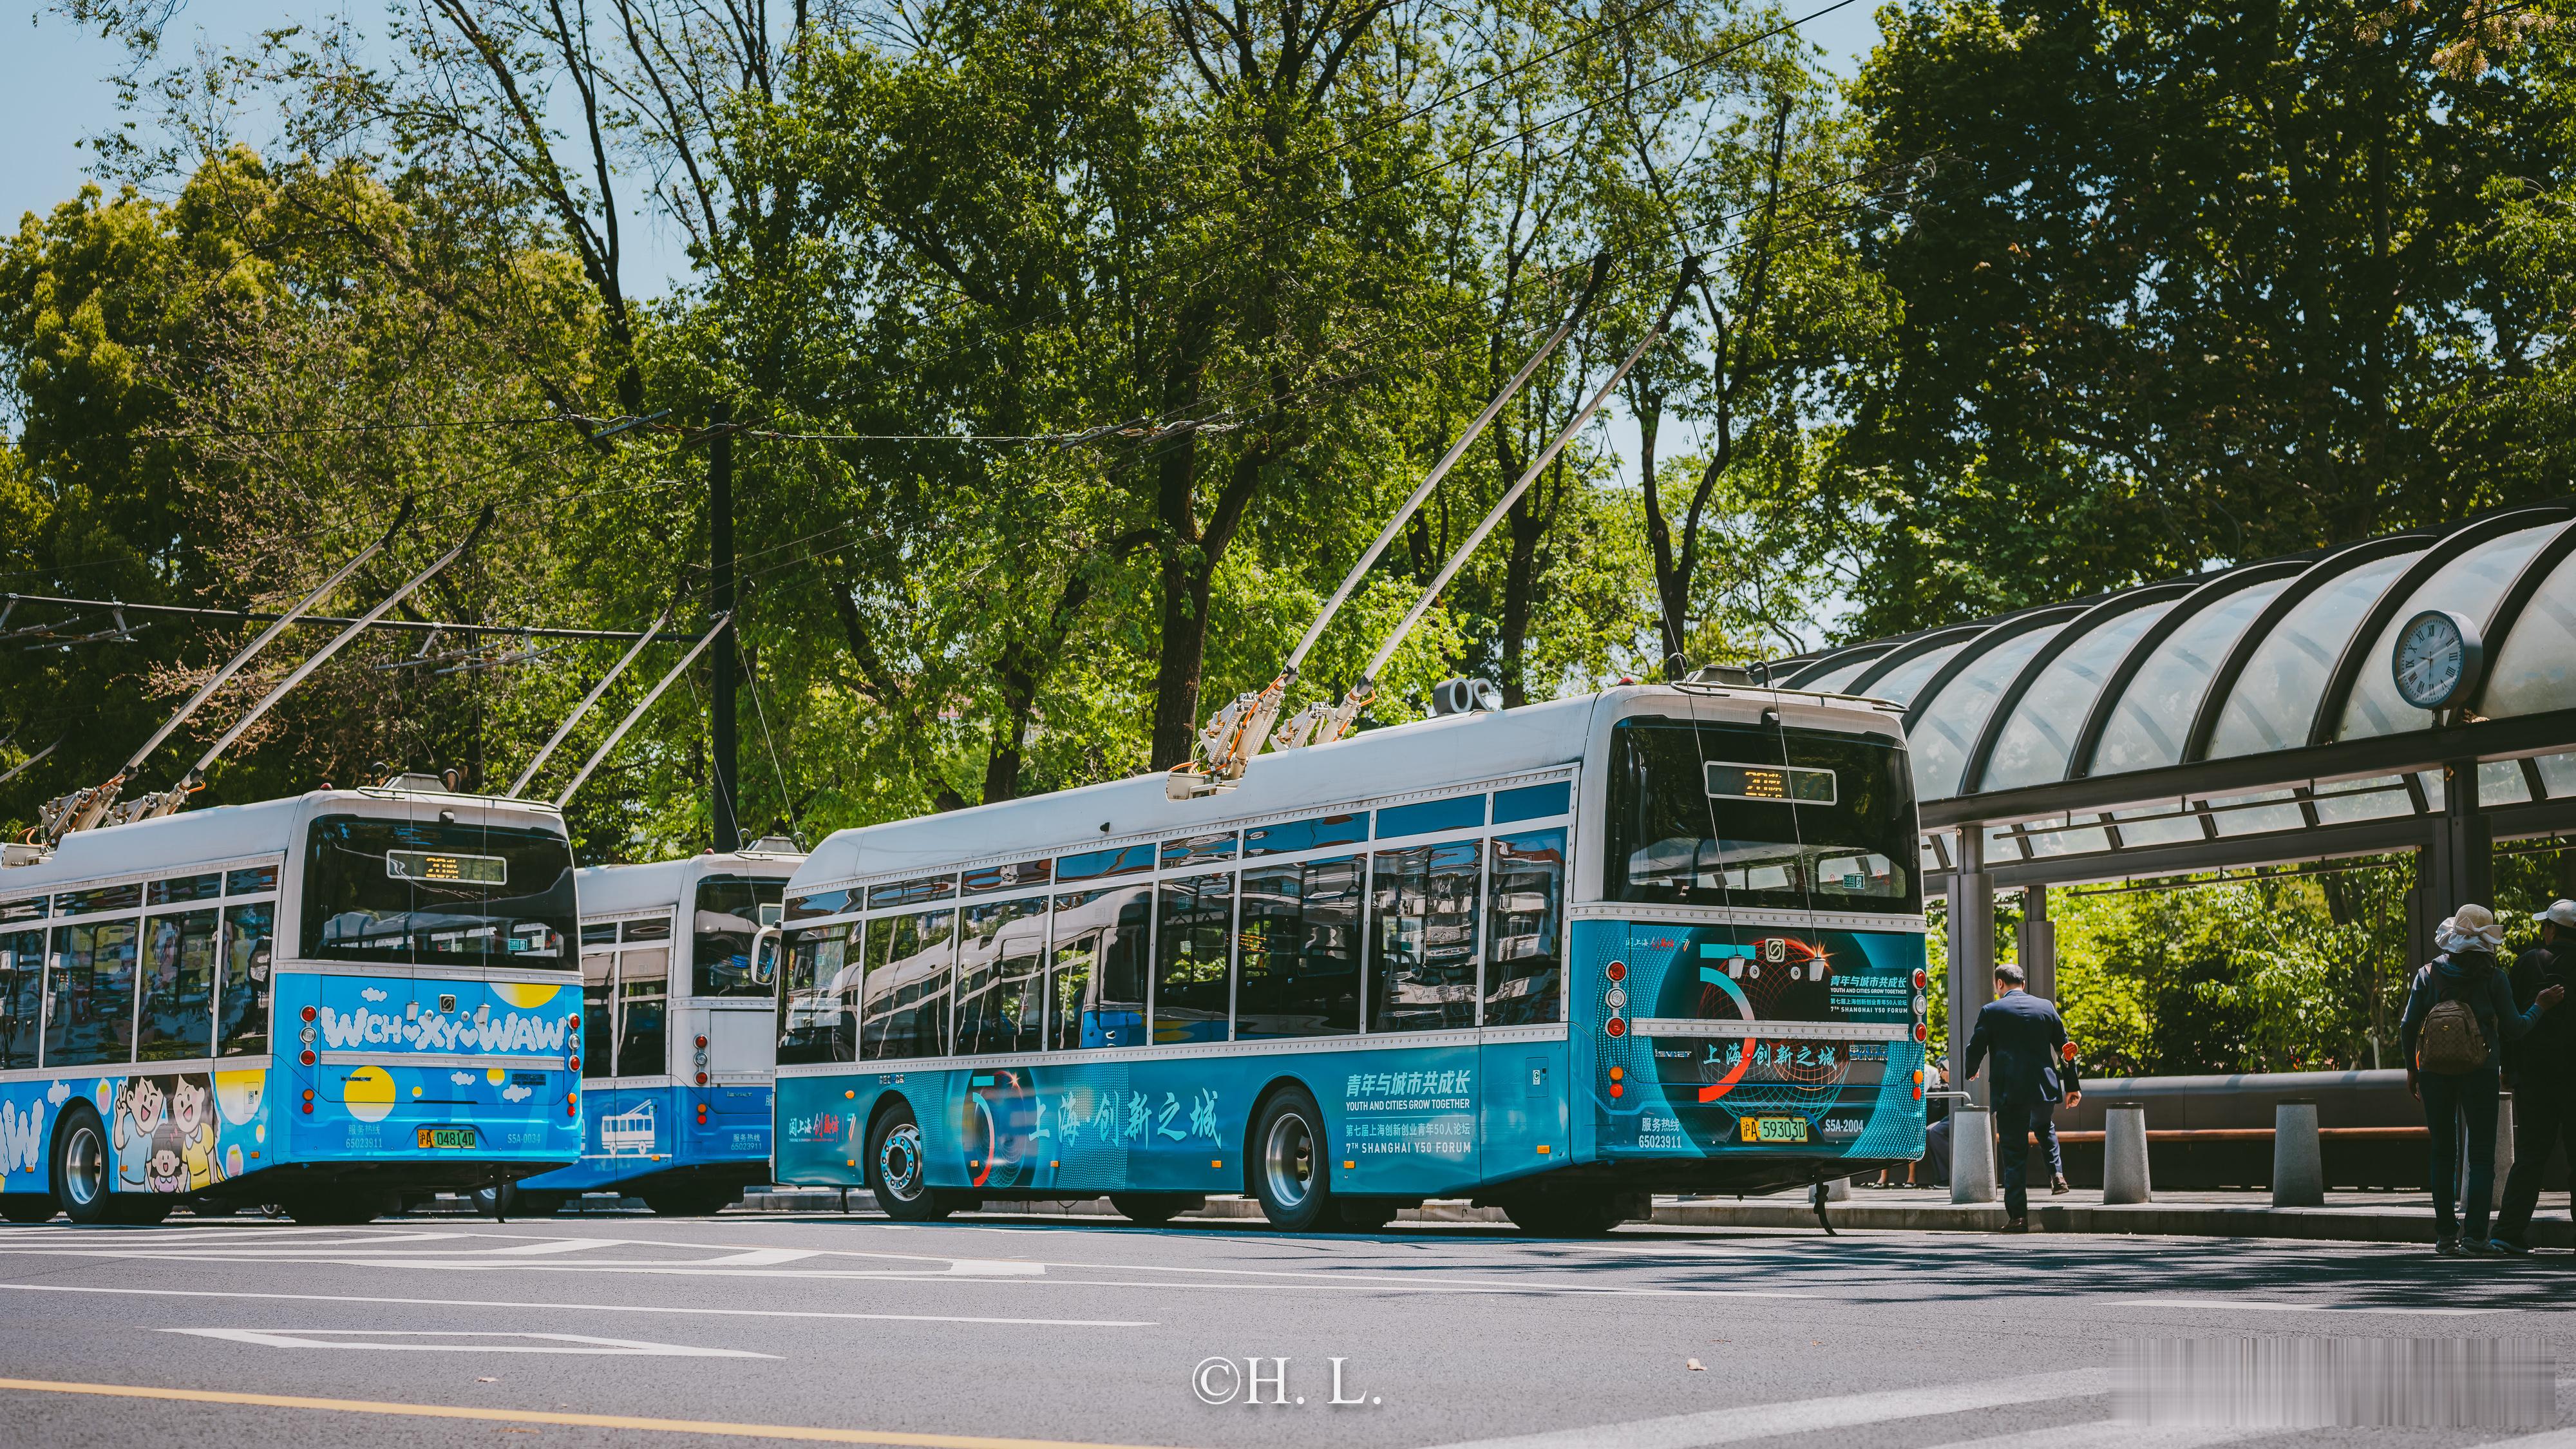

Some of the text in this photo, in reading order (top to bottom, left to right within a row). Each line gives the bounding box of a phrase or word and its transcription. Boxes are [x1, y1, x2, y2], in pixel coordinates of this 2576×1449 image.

[1830, 975, 1907, 988] 青年与城市共成长
[1346, 1070, 1471, 1097] 青年与城市共成长
[1346, 1099, 1470, 1112] YOUTH AND CITIES GROW TOGETHER
[348, 1124, 381, 1135] 服务热线
[1346, 1122, 1470, 1137] 第七届上海创新创业青年50人论坛
[1642, 1117, 1680, 1132] 服务热线
[1825, 1119, 1864, 1133] S5A-2004
[346, 1138, 382, 1148] 65023911
[507, 1133, 540, 1144] S5A-0034
[733, 1133, 761, 1142] 服务热线
[1638, 1135, 1682, 1148] 65023911
[1361, 1142, 1410, 1153] SHANGHAI
[1414, 1142, 1432, 1153] Y50
[1435, 1142, 1471, 1153] FORUM
